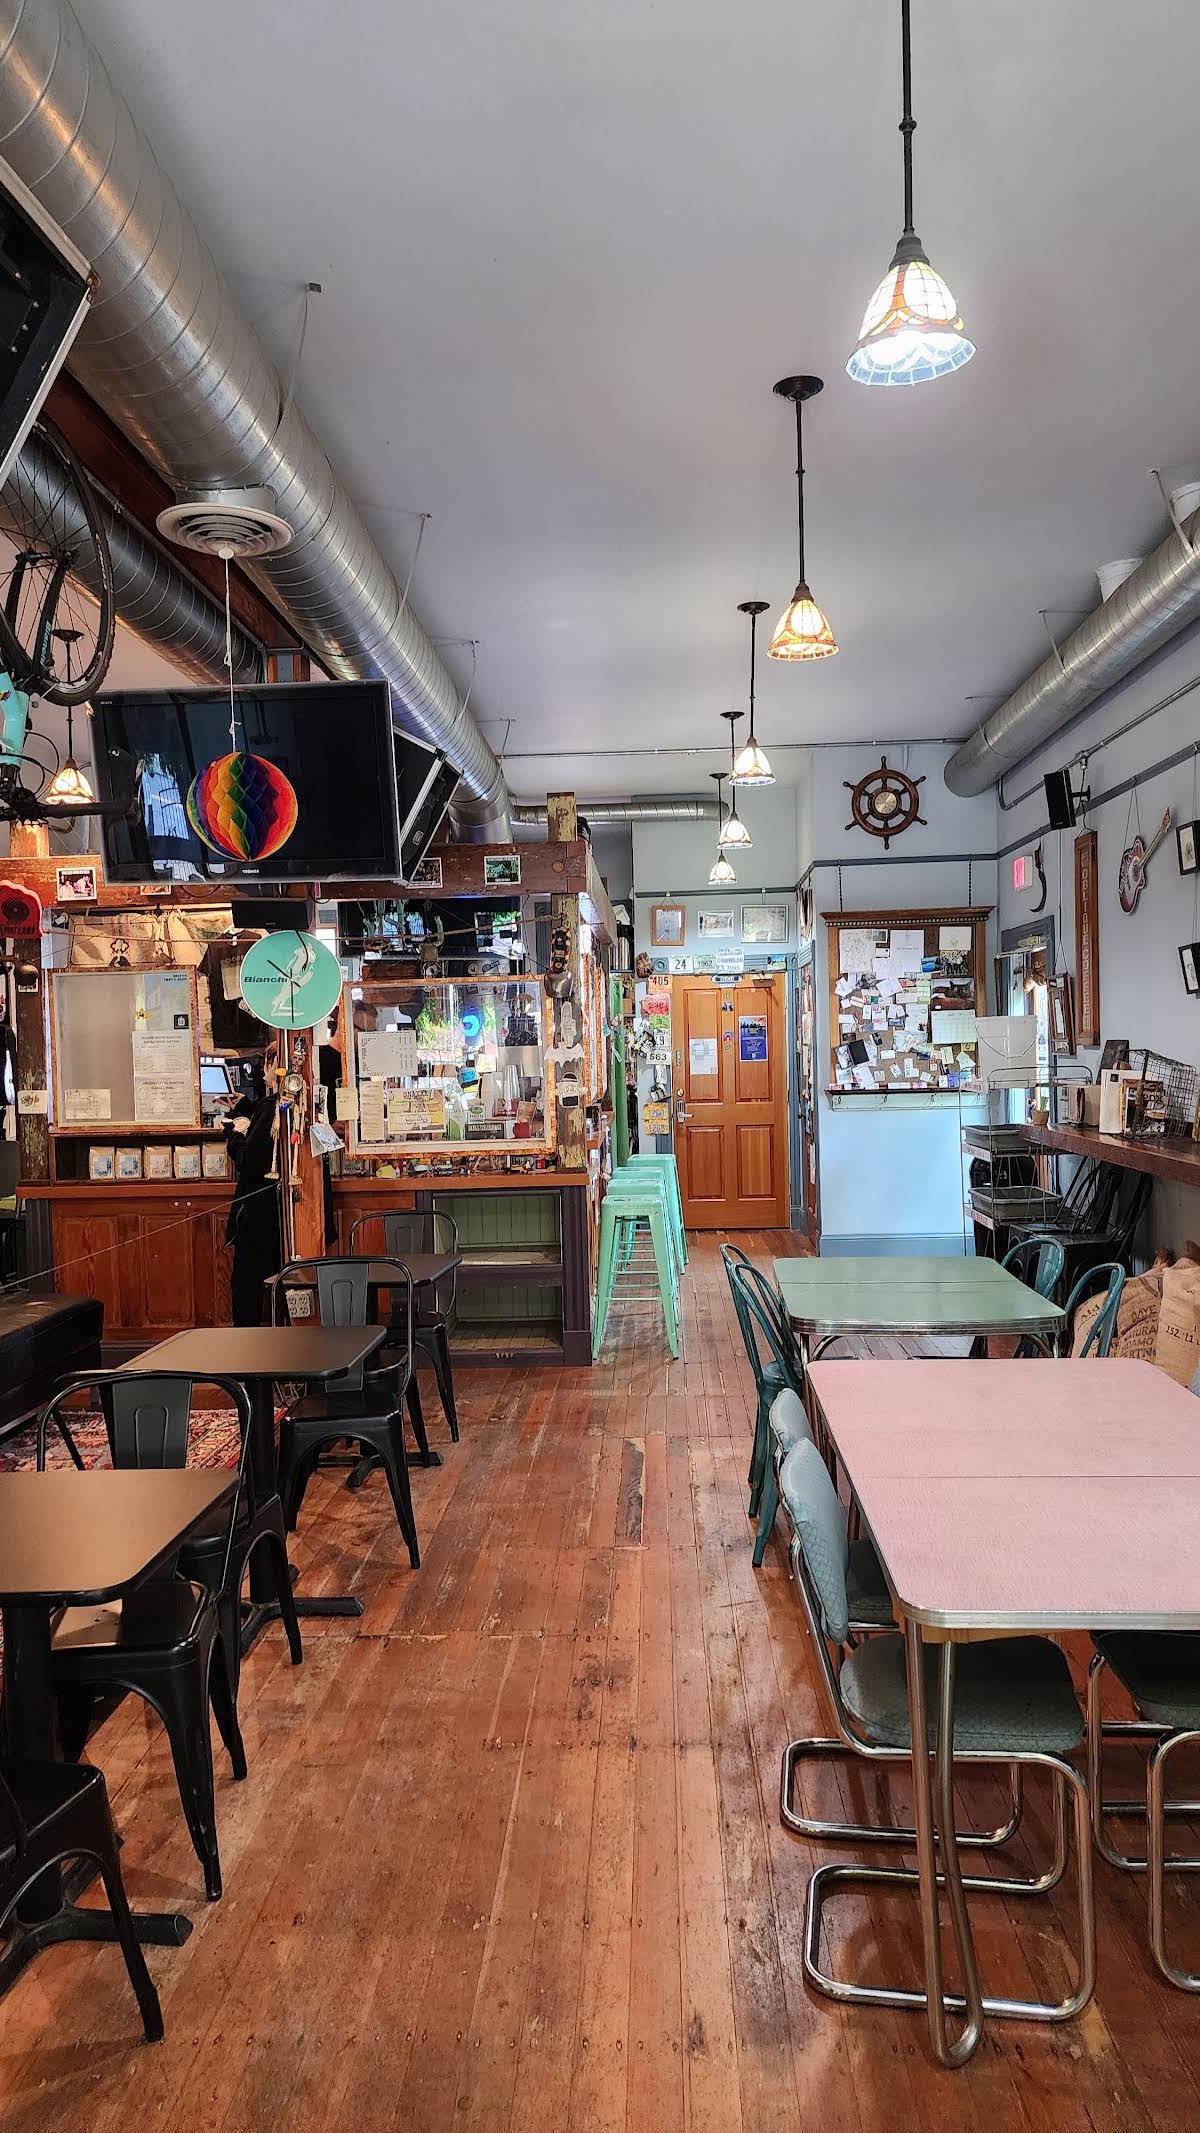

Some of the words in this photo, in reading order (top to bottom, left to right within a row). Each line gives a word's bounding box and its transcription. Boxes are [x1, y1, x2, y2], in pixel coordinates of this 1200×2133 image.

[40, 620, 51, 664] Bianchi
[675, 958, 687, 970] 24
[649, 1053, 667, 1061] 563
